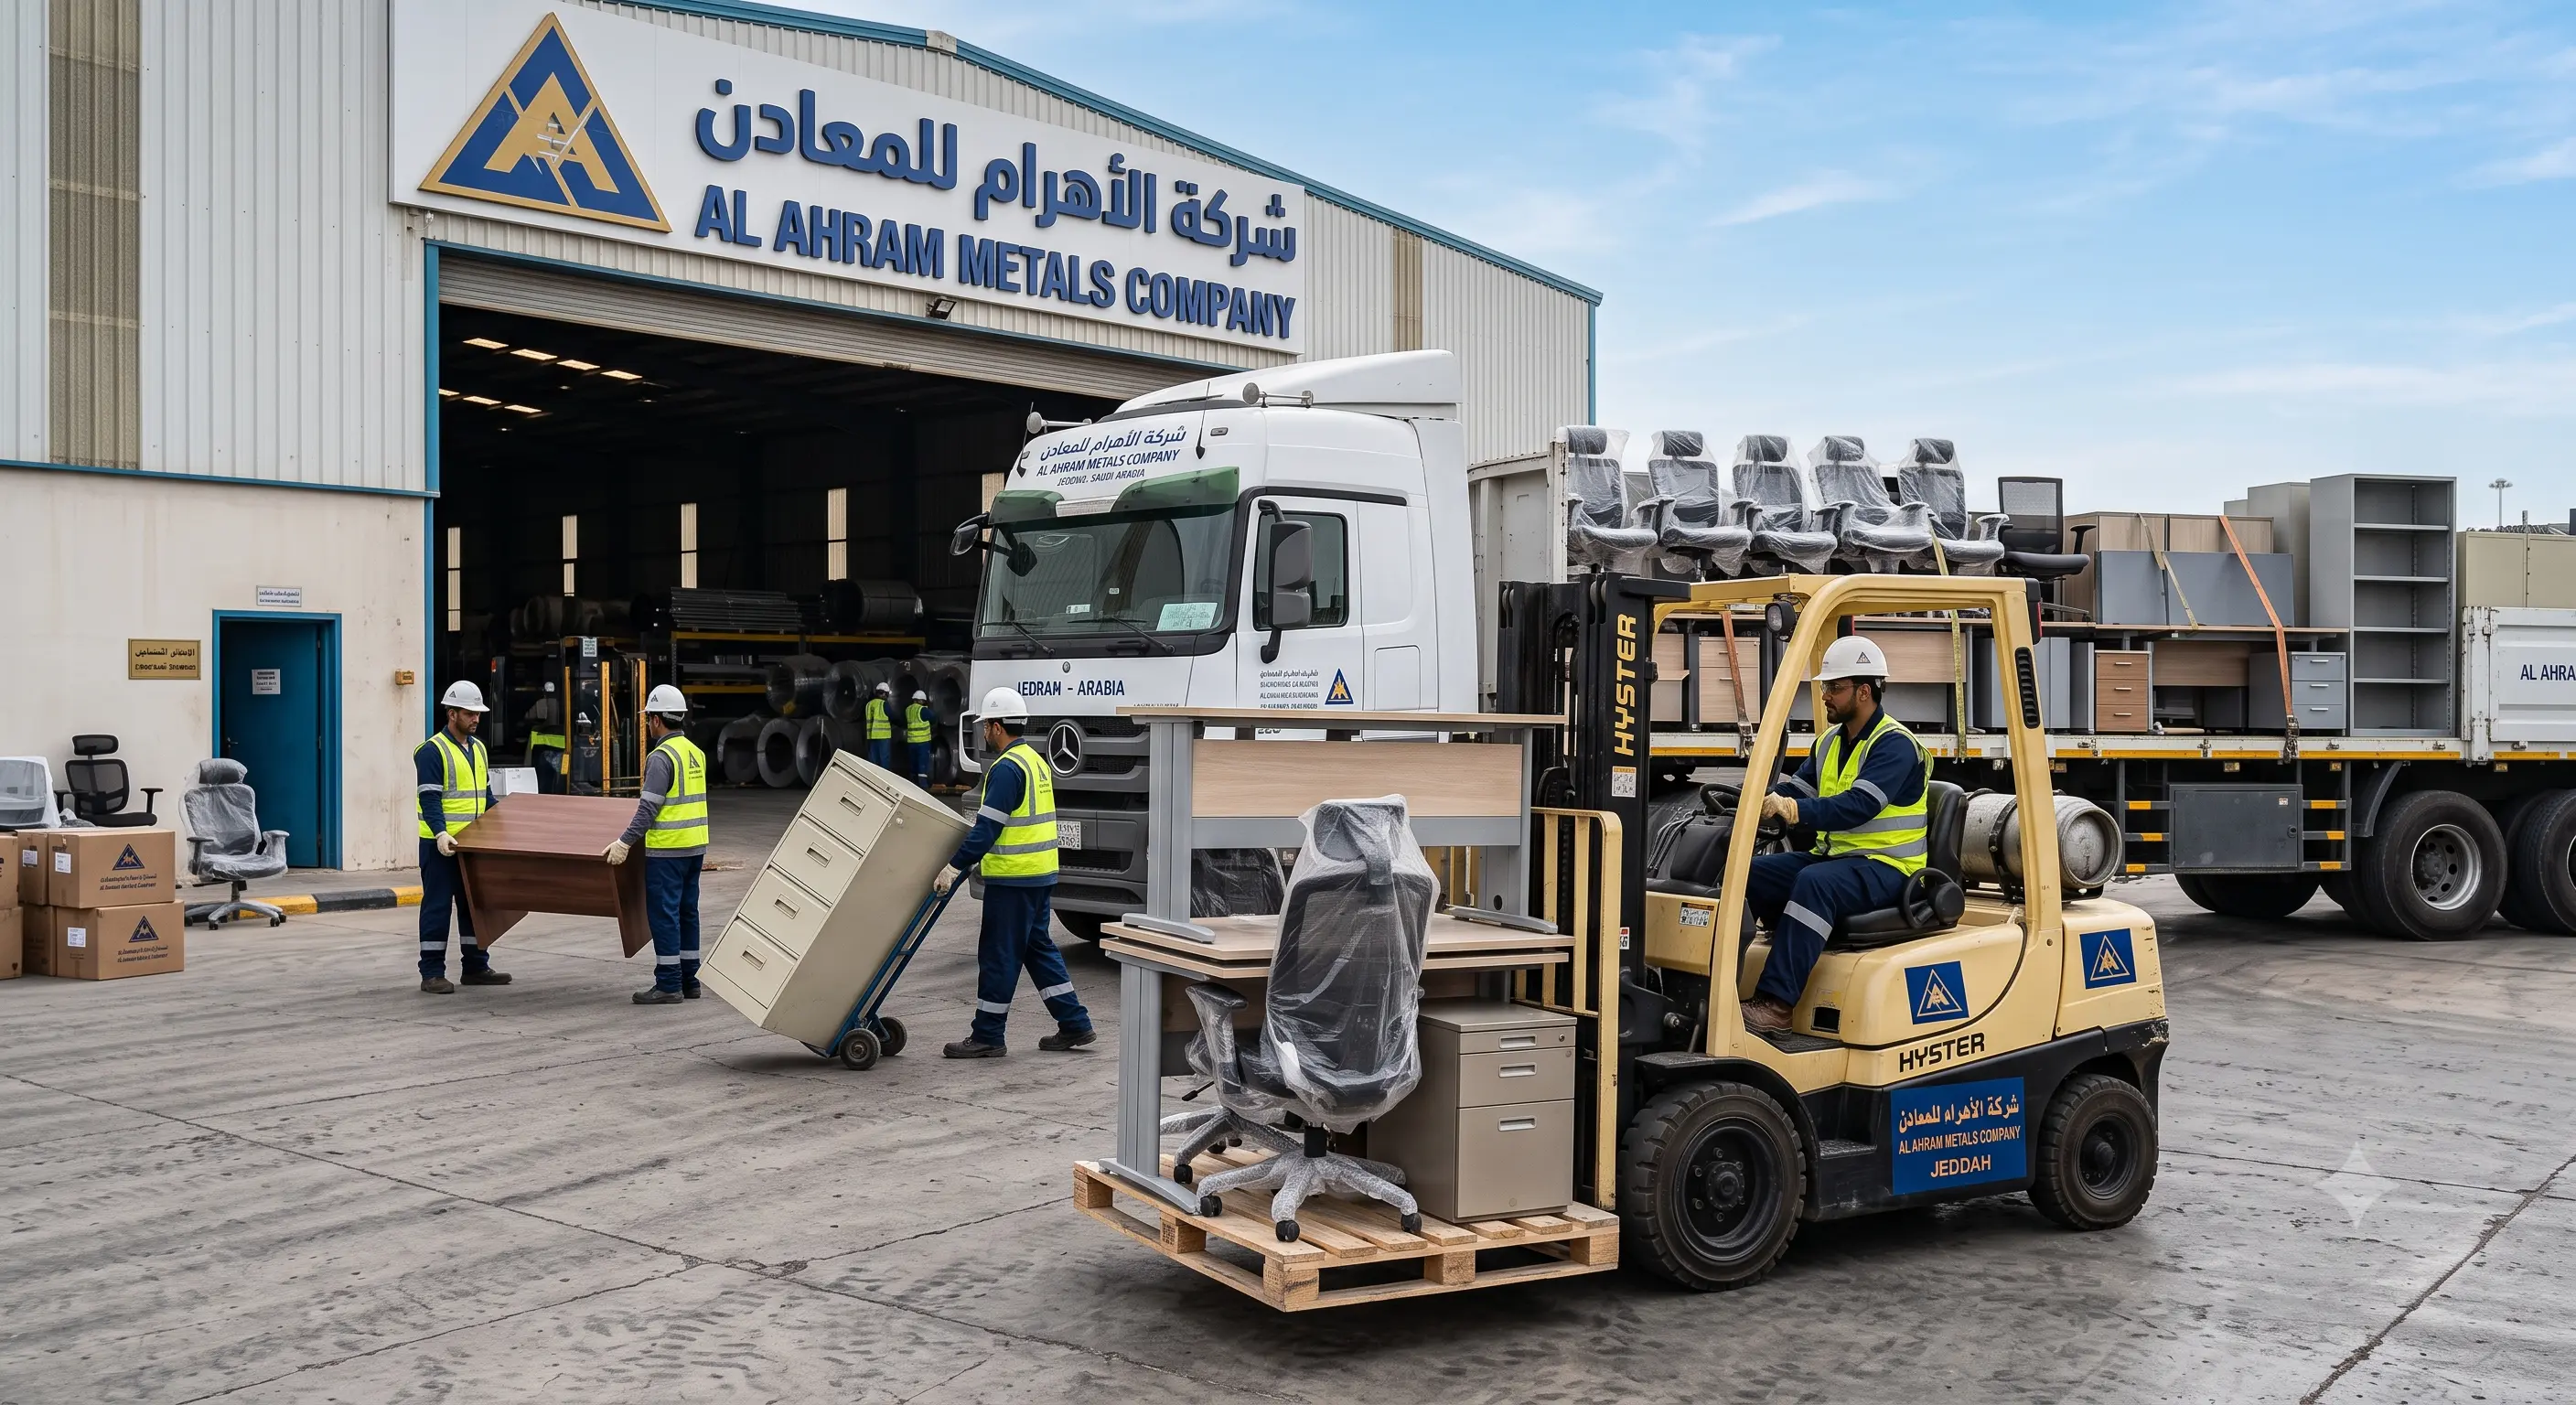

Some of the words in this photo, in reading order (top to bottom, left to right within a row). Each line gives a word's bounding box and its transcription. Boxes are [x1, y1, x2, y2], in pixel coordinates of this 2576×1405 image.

[694, 78, 959, 191] للمعادن
[973, 142, 1157, 234] الأهرام
[1170, 179, 1297, 267] شركة
[693, 184, 763, 248] AL
[773, 199, 945, 279] AHRAM
[958, 233, 1116, 308] METALS
[1125, 267, 1297, 339] COMPANY
[1039, 436, 1092, 462] للمعادن
[1089, 429, 1143, 456] الأهرام
[1143, 424, 1187, 447] شركة
[1036, 466, 1048, 477] AL
[1049, 460, 1086, 475] AHRAM
[1086, 455, 1125, 470] METALS
[1126, 449, 1181, 467] COMPANY
[1090, 472, 1115, 483] SAUDI
[1614, 613, 1637, 756] HYSTER
[2520, 664, 2538, 681] AL
[1077, 681, 1125, 696] ARABIA
[1899, 1032, 1986, 1073] HYSTER
[1987, 1094, 2020, 1119] شركة
[1898, 1140, 1911, 1154] AL
[1912, 1135, 1943, 1153] AHRAM
[1945, 1132, 1979, 1148] METALS
[1980, 1125, 2022, 1142] COMPANY
[1930, 1154, 1991, 1178] JEDDAH
